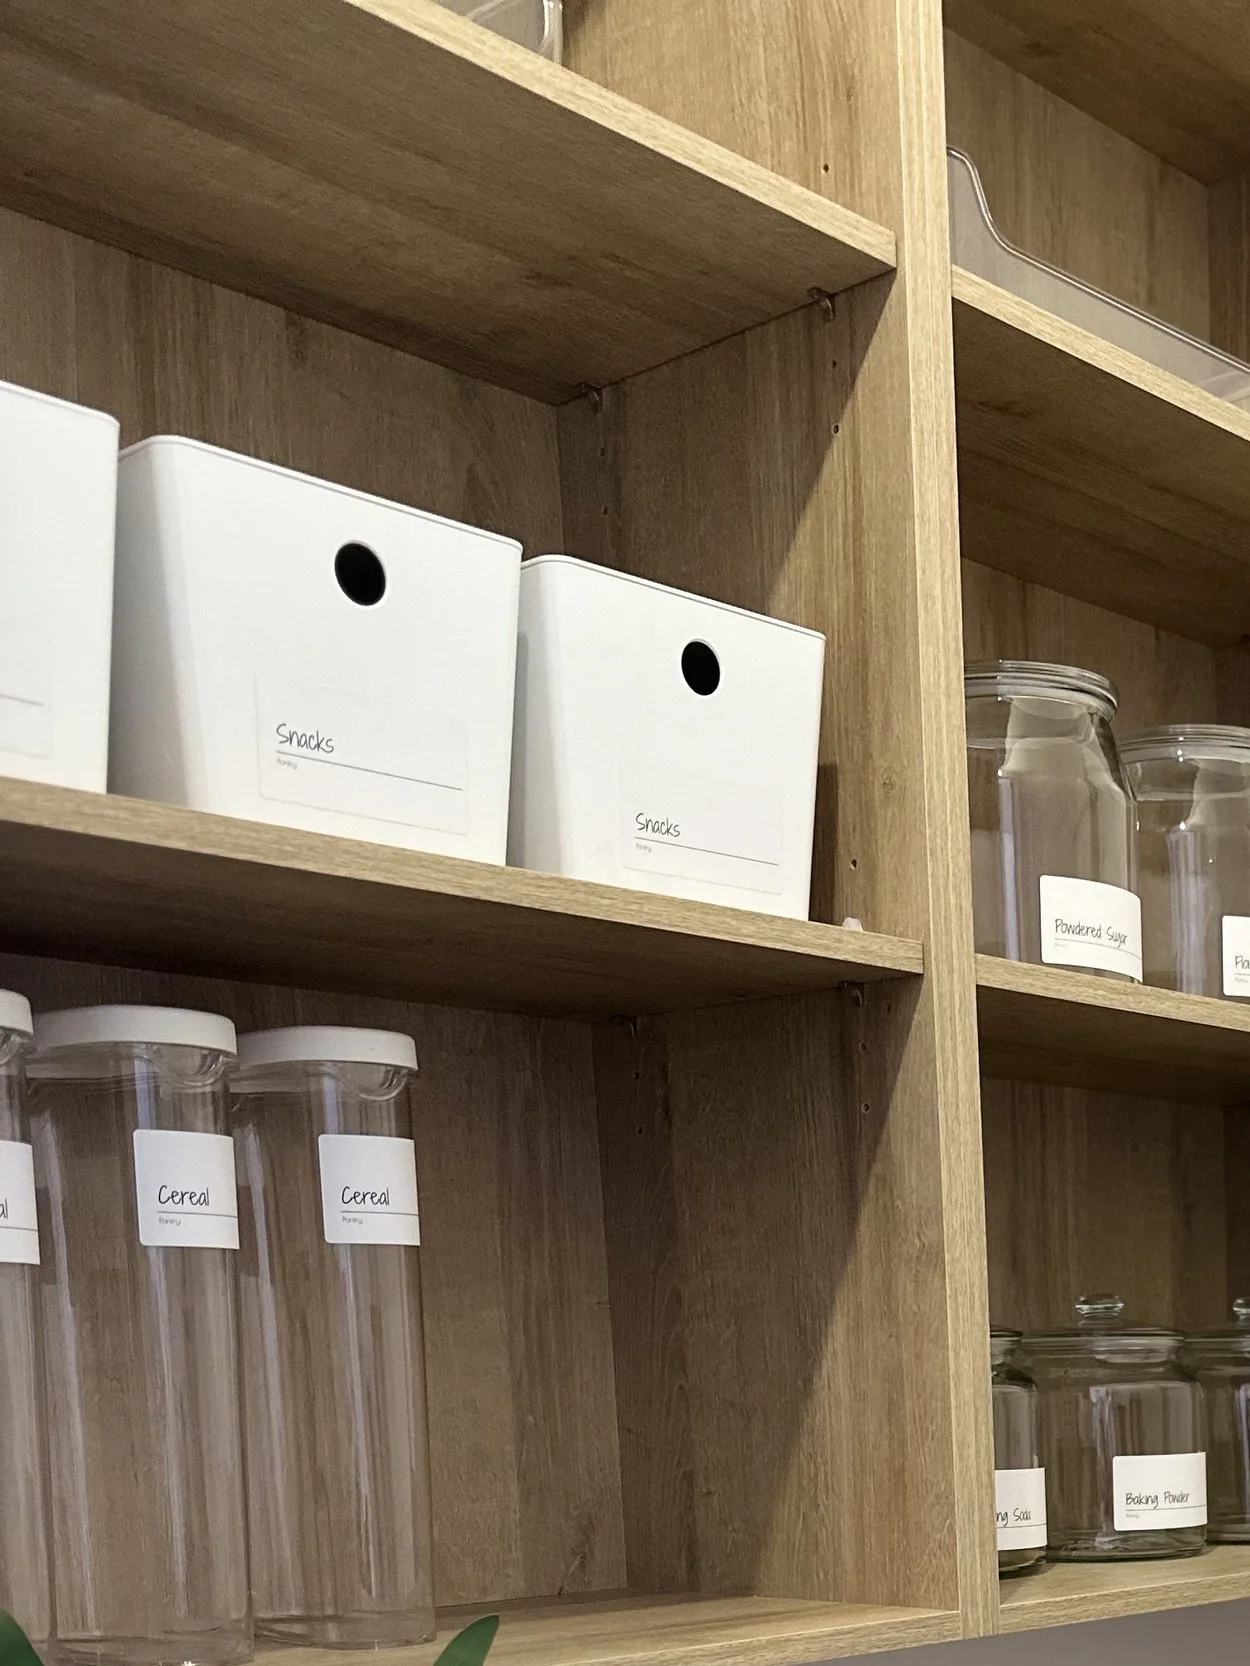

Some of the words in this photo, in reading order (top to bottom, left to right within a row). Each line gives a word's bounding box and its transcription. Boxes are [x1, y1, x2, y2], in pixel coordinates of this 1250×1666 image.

[276, 722, 335, 754] Snacks
[635, 812, 681, 838] Snacks
[1054, 918, 1102, 940] Powdered
[1106, 926, 1128, 949] Sugar
[158, 1184, 210, 1207] Cereal
[341, 1185, 390, 1206] Cereal
[1125, 1492, 1159, 1510] Baking
